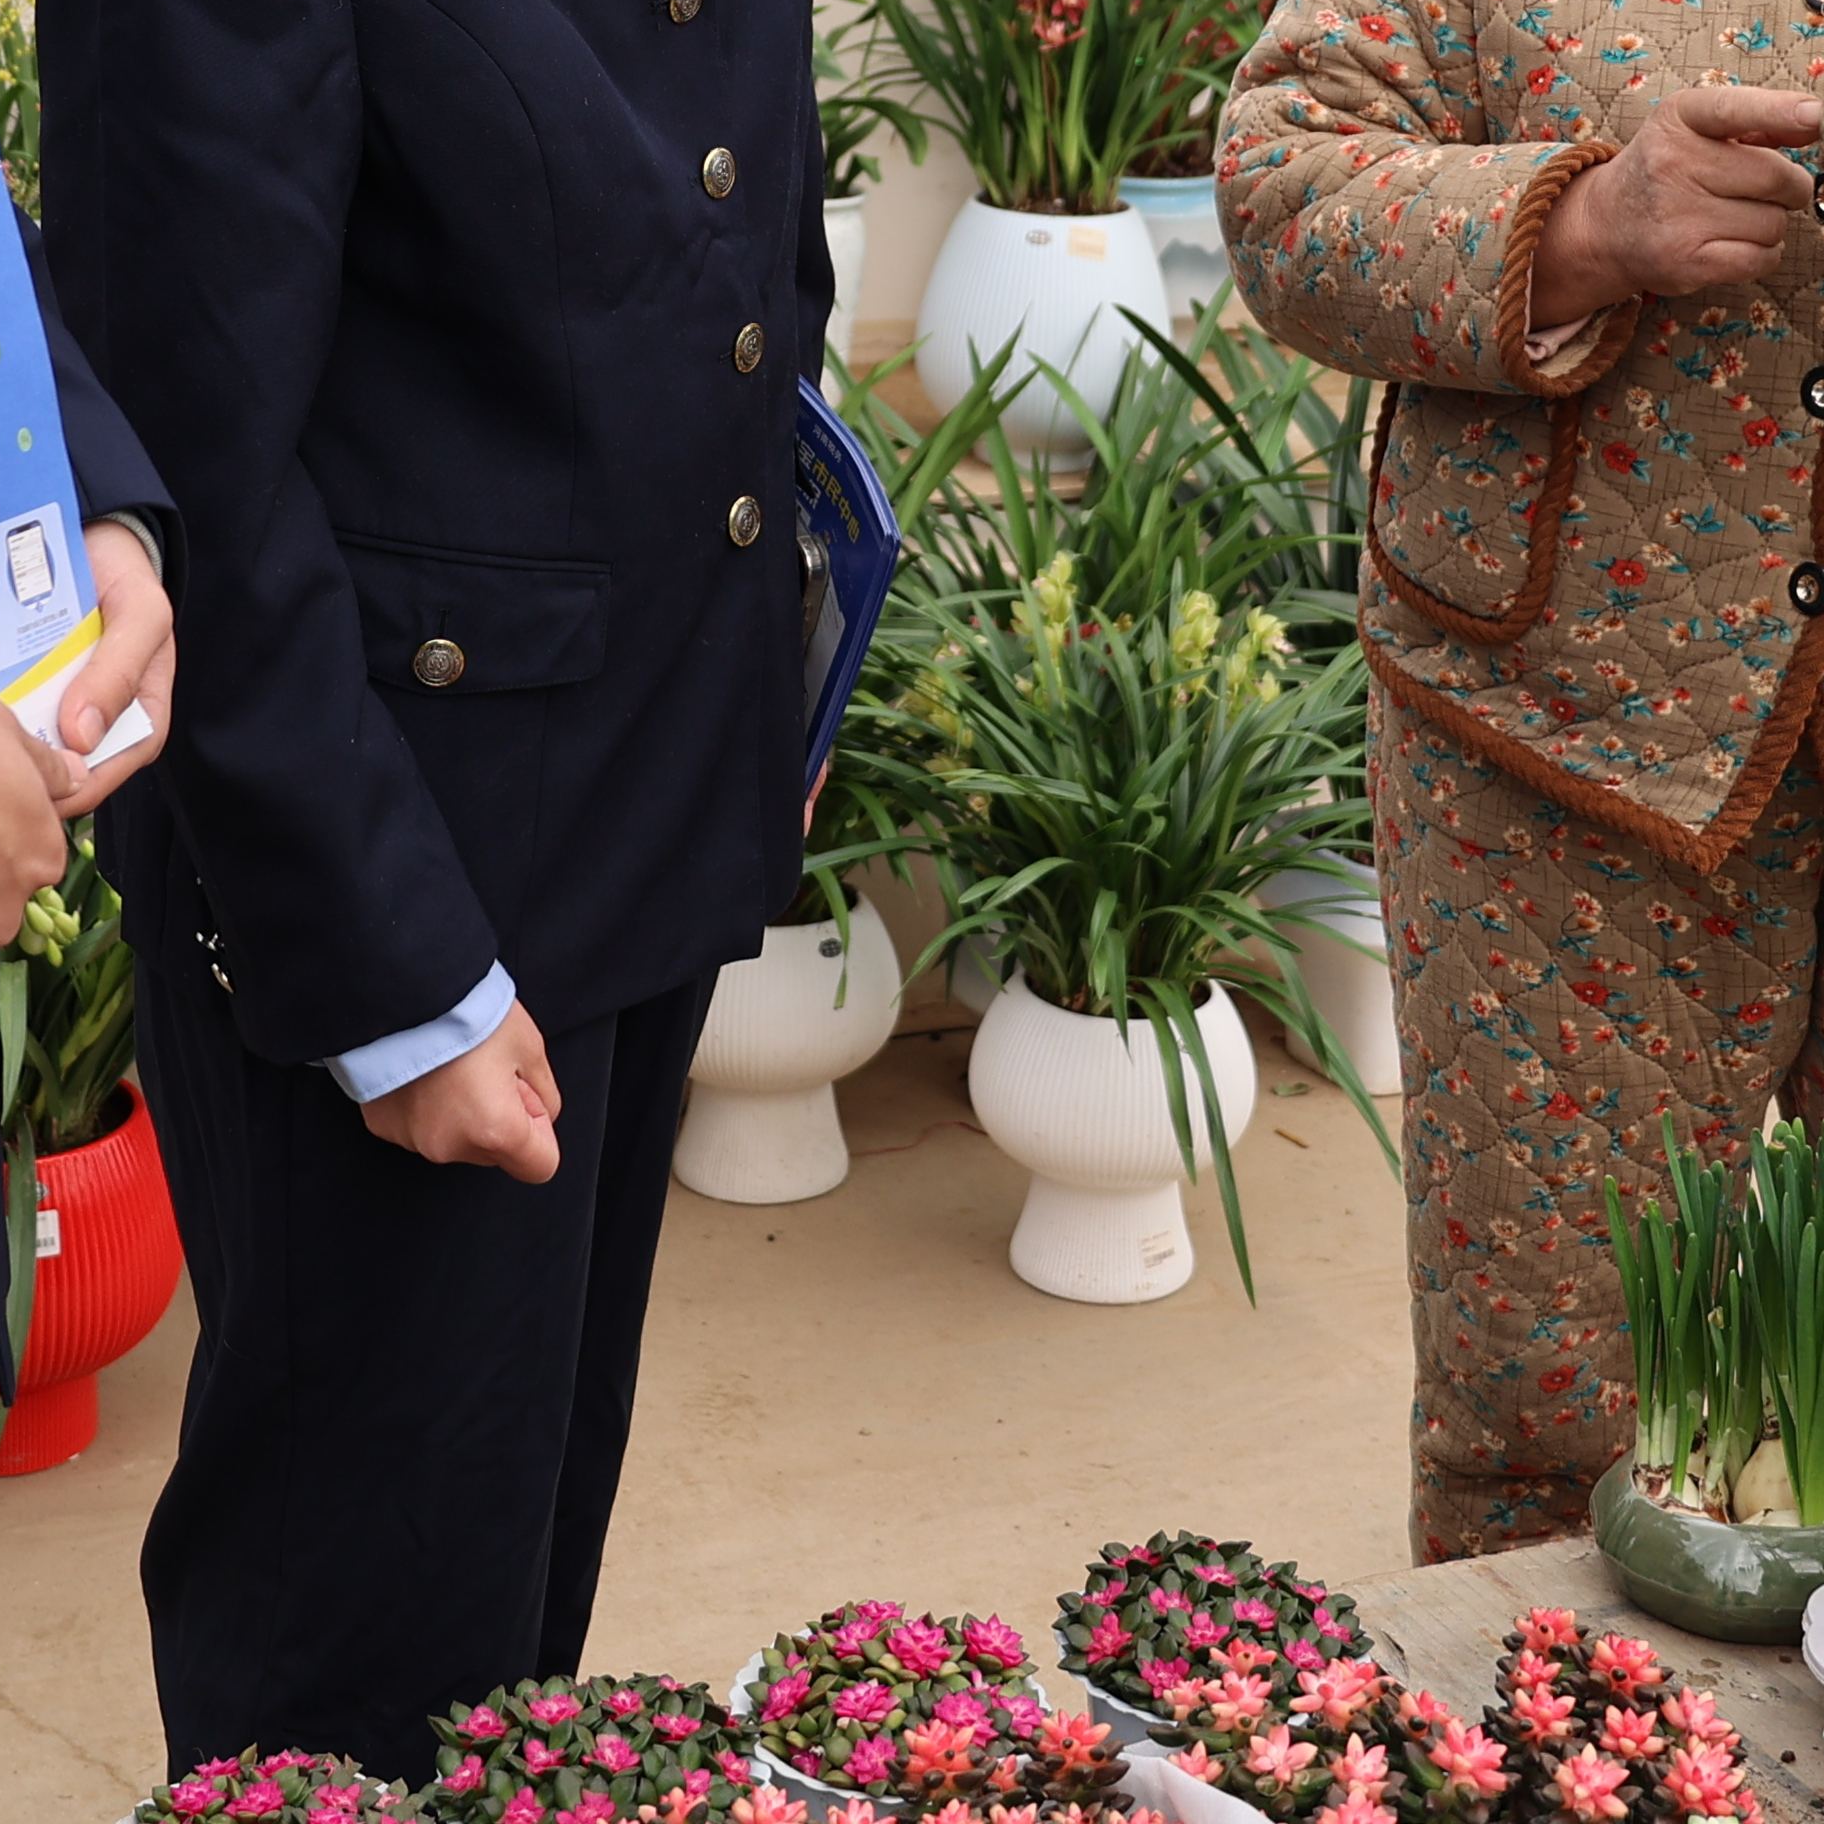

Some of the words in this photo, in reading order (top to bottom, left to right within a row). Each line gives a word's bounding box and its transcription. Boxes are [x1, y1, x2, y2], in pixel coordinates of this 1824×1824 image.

[796, 433, 860, 543] 宝市民中心
